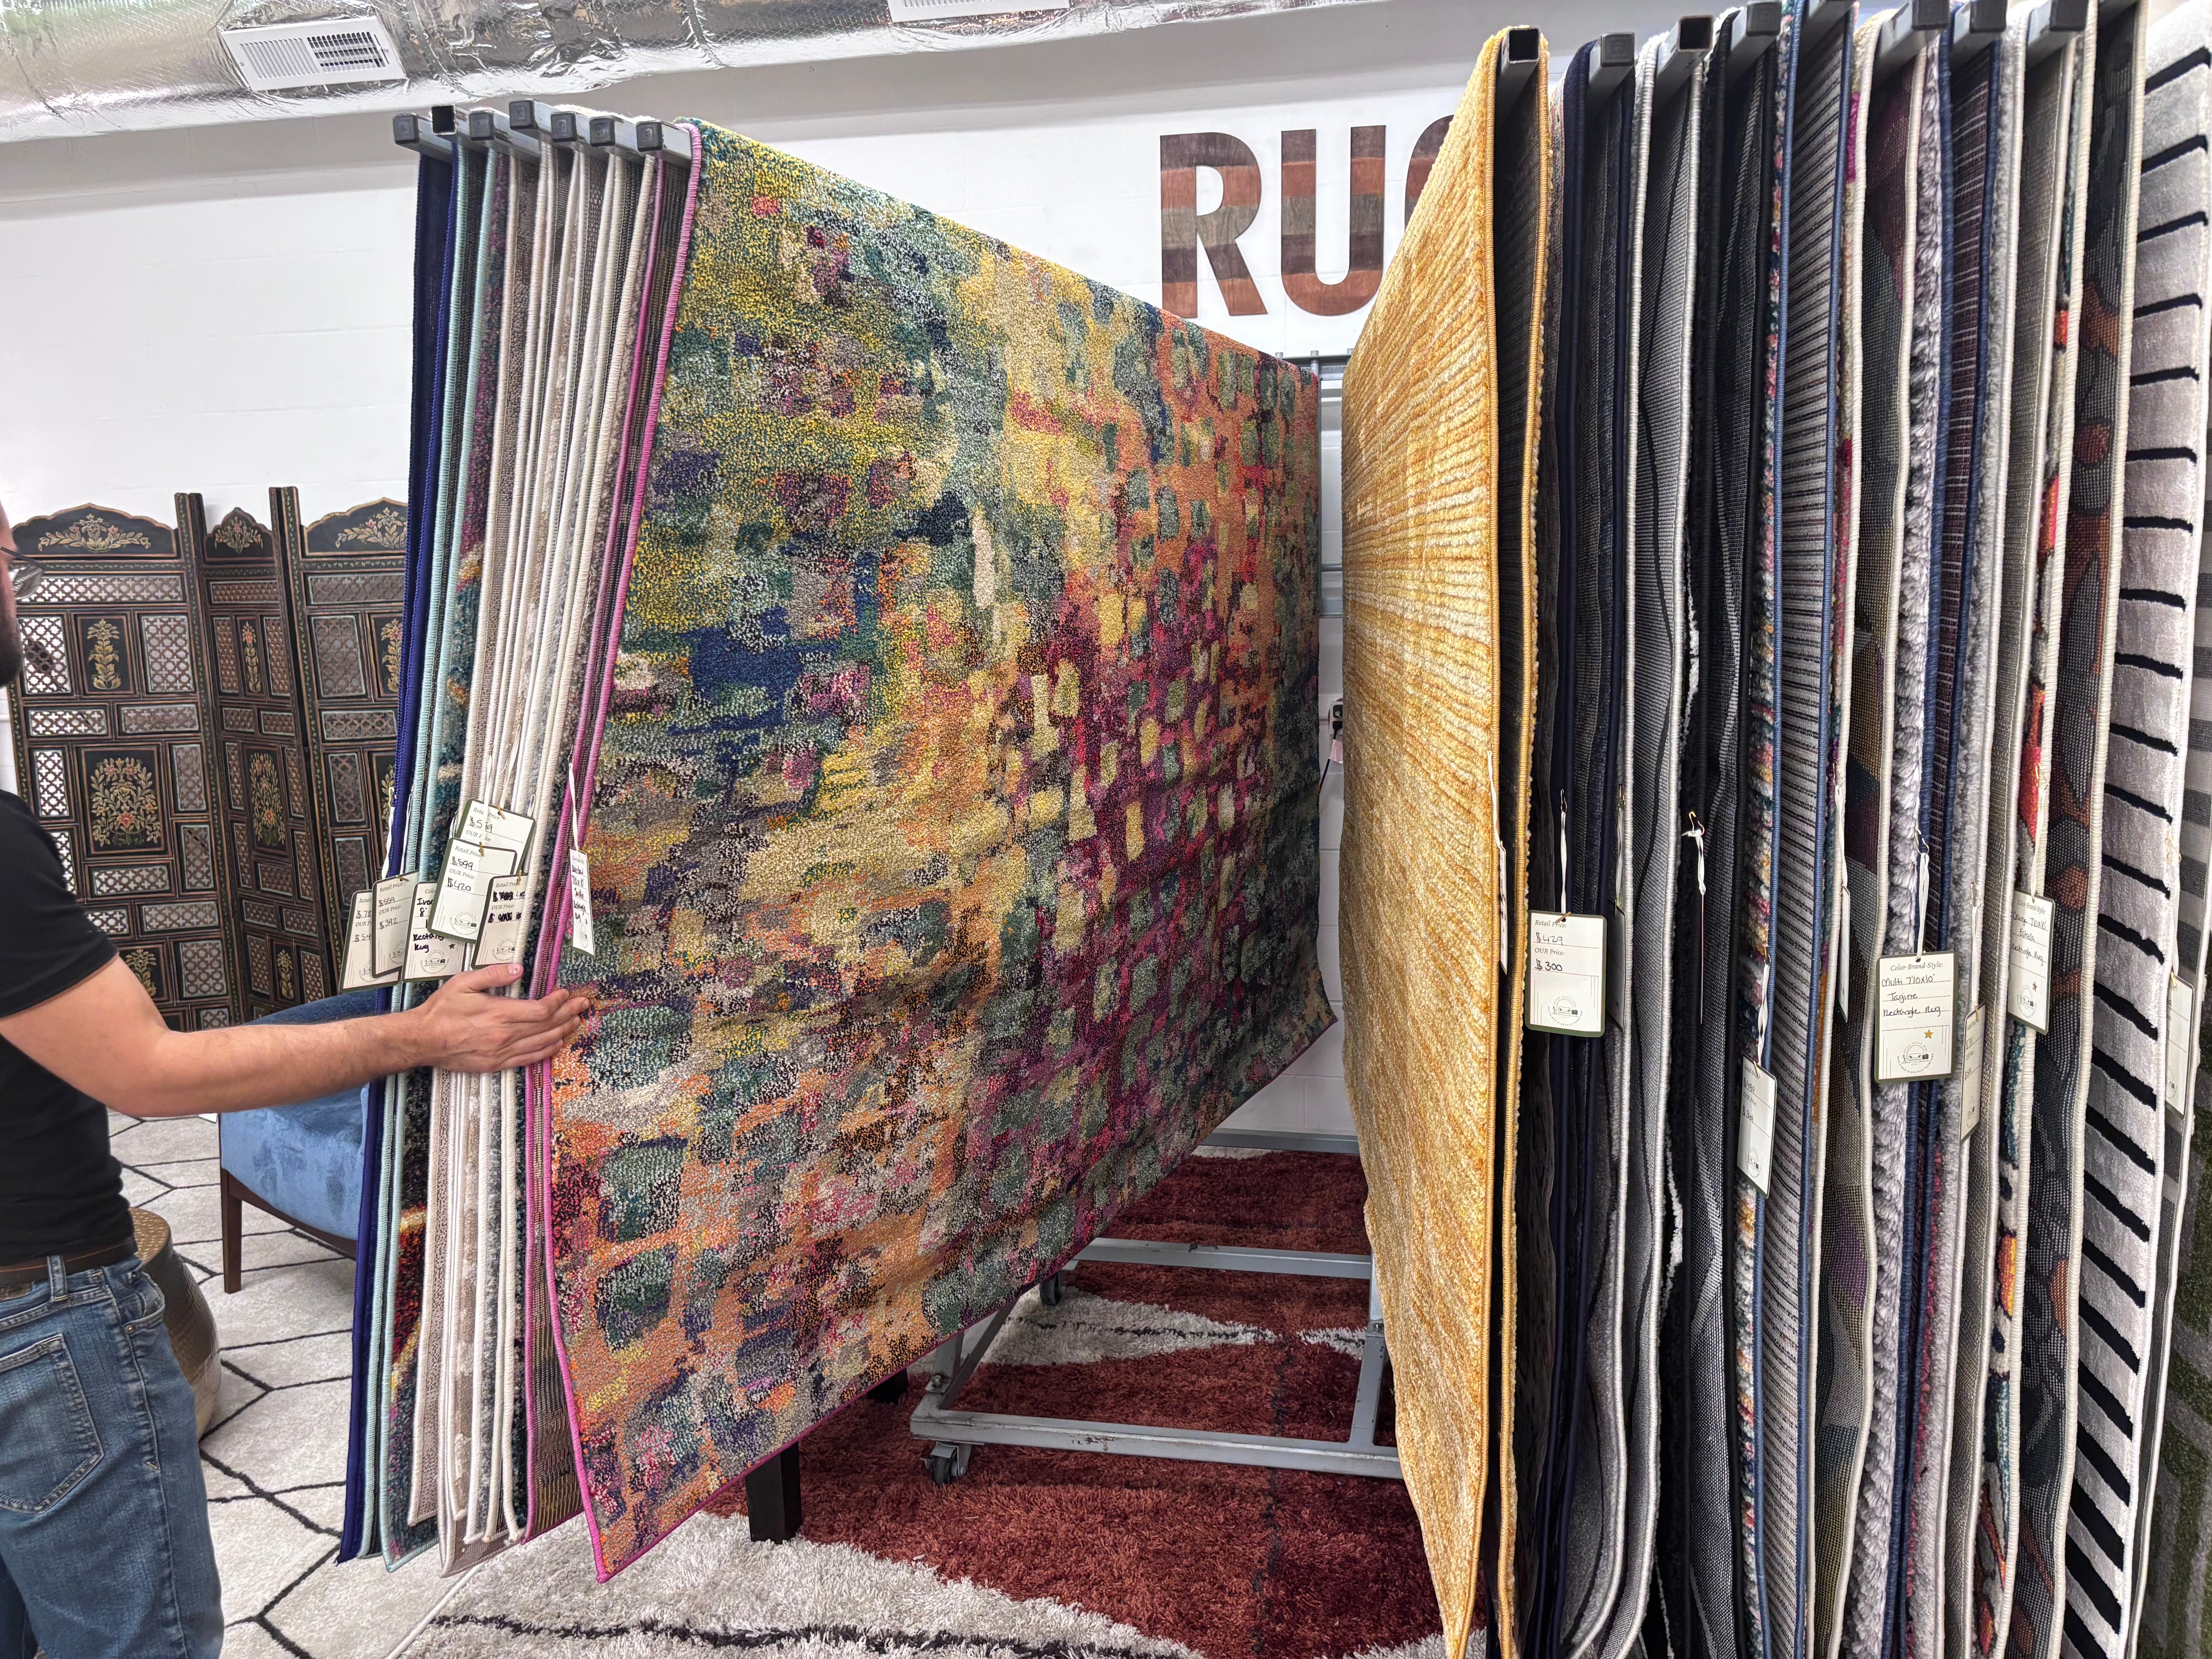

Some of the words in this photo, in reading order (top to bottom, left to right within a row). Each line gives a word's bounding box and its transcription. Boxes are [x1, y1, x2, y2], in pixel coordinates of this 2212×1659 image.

[452, 856, 473, 871] $599
[448, 877, 471, 891] $420
[380, 917, 398, 930] $392
[1536, 932, 1563, 946] $429
[414, 943, 429, 953] Rug
[1891, 961, 1943, 971] Color-Brand-Style:
[1882, 977, 1903, 987] Multi
[1887, 992, 1918, 1003] Tagine
[1925, 1006, 1941, 1017] Rug
